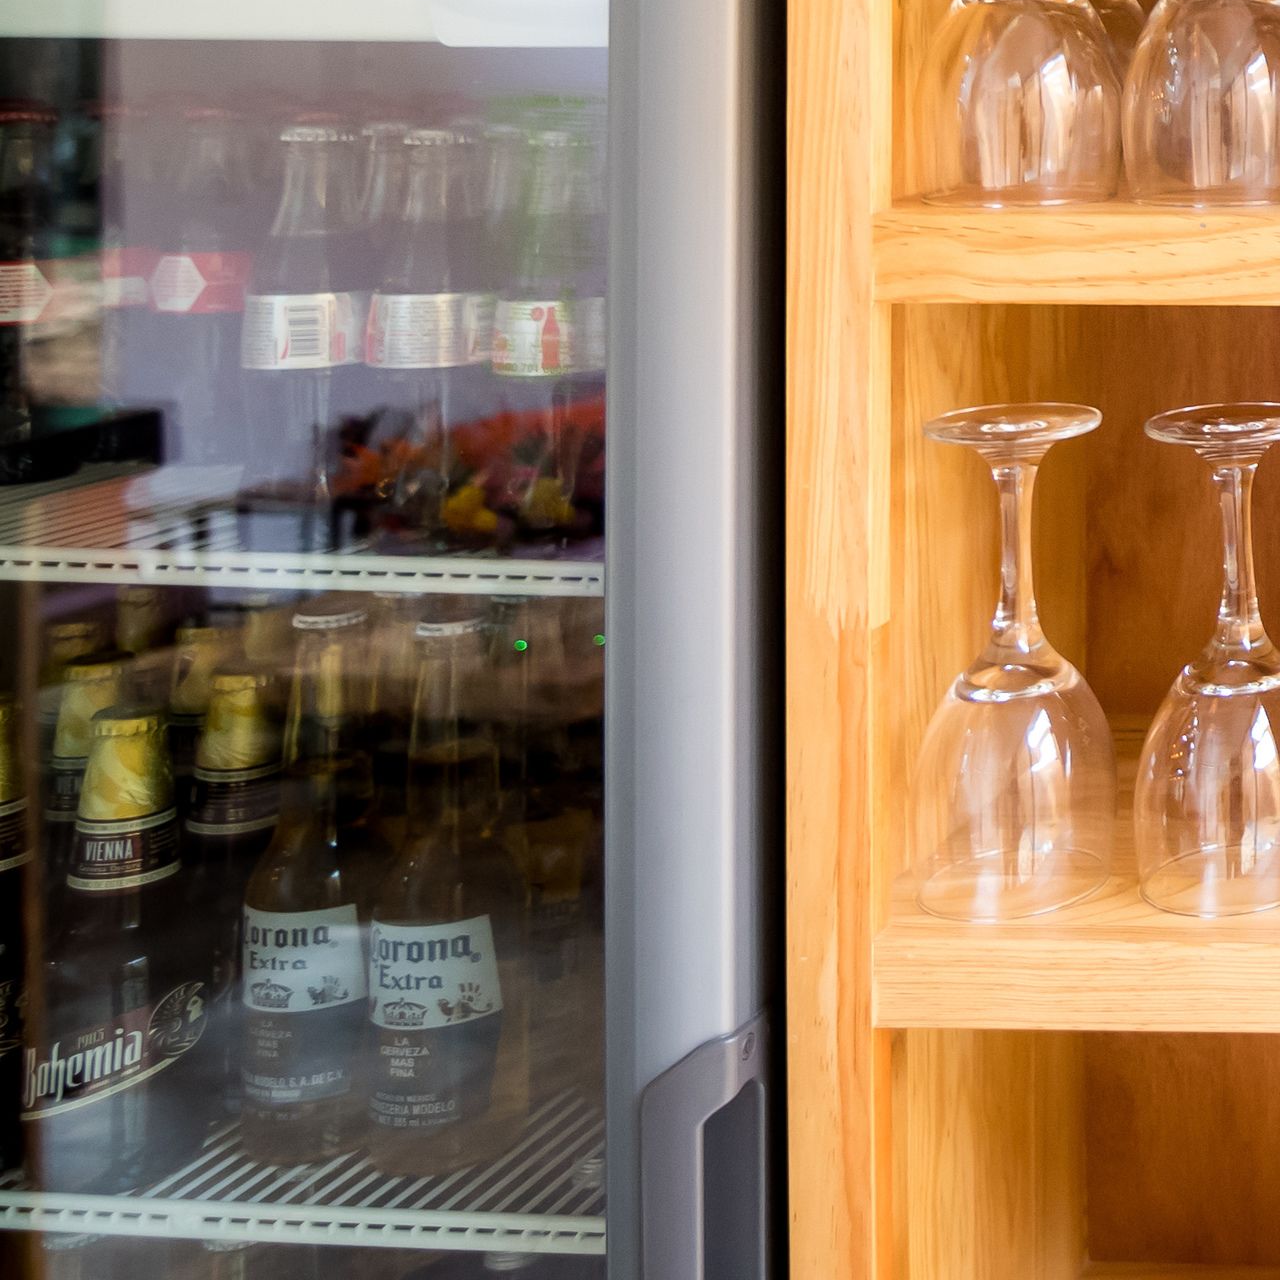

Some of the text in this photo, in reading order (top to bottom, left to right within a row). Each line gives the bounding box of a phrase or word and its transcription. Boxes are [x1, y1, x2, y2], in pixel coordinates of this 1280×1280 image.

[86, 839, 134, 861] VIENNA
[250, 951, 309, 971] Extra
[379, 964, 444, 990] Extra
[381, 1045, 430, 1057] CERVEZA
[24, 1027, 144, 1109] Bohemia
